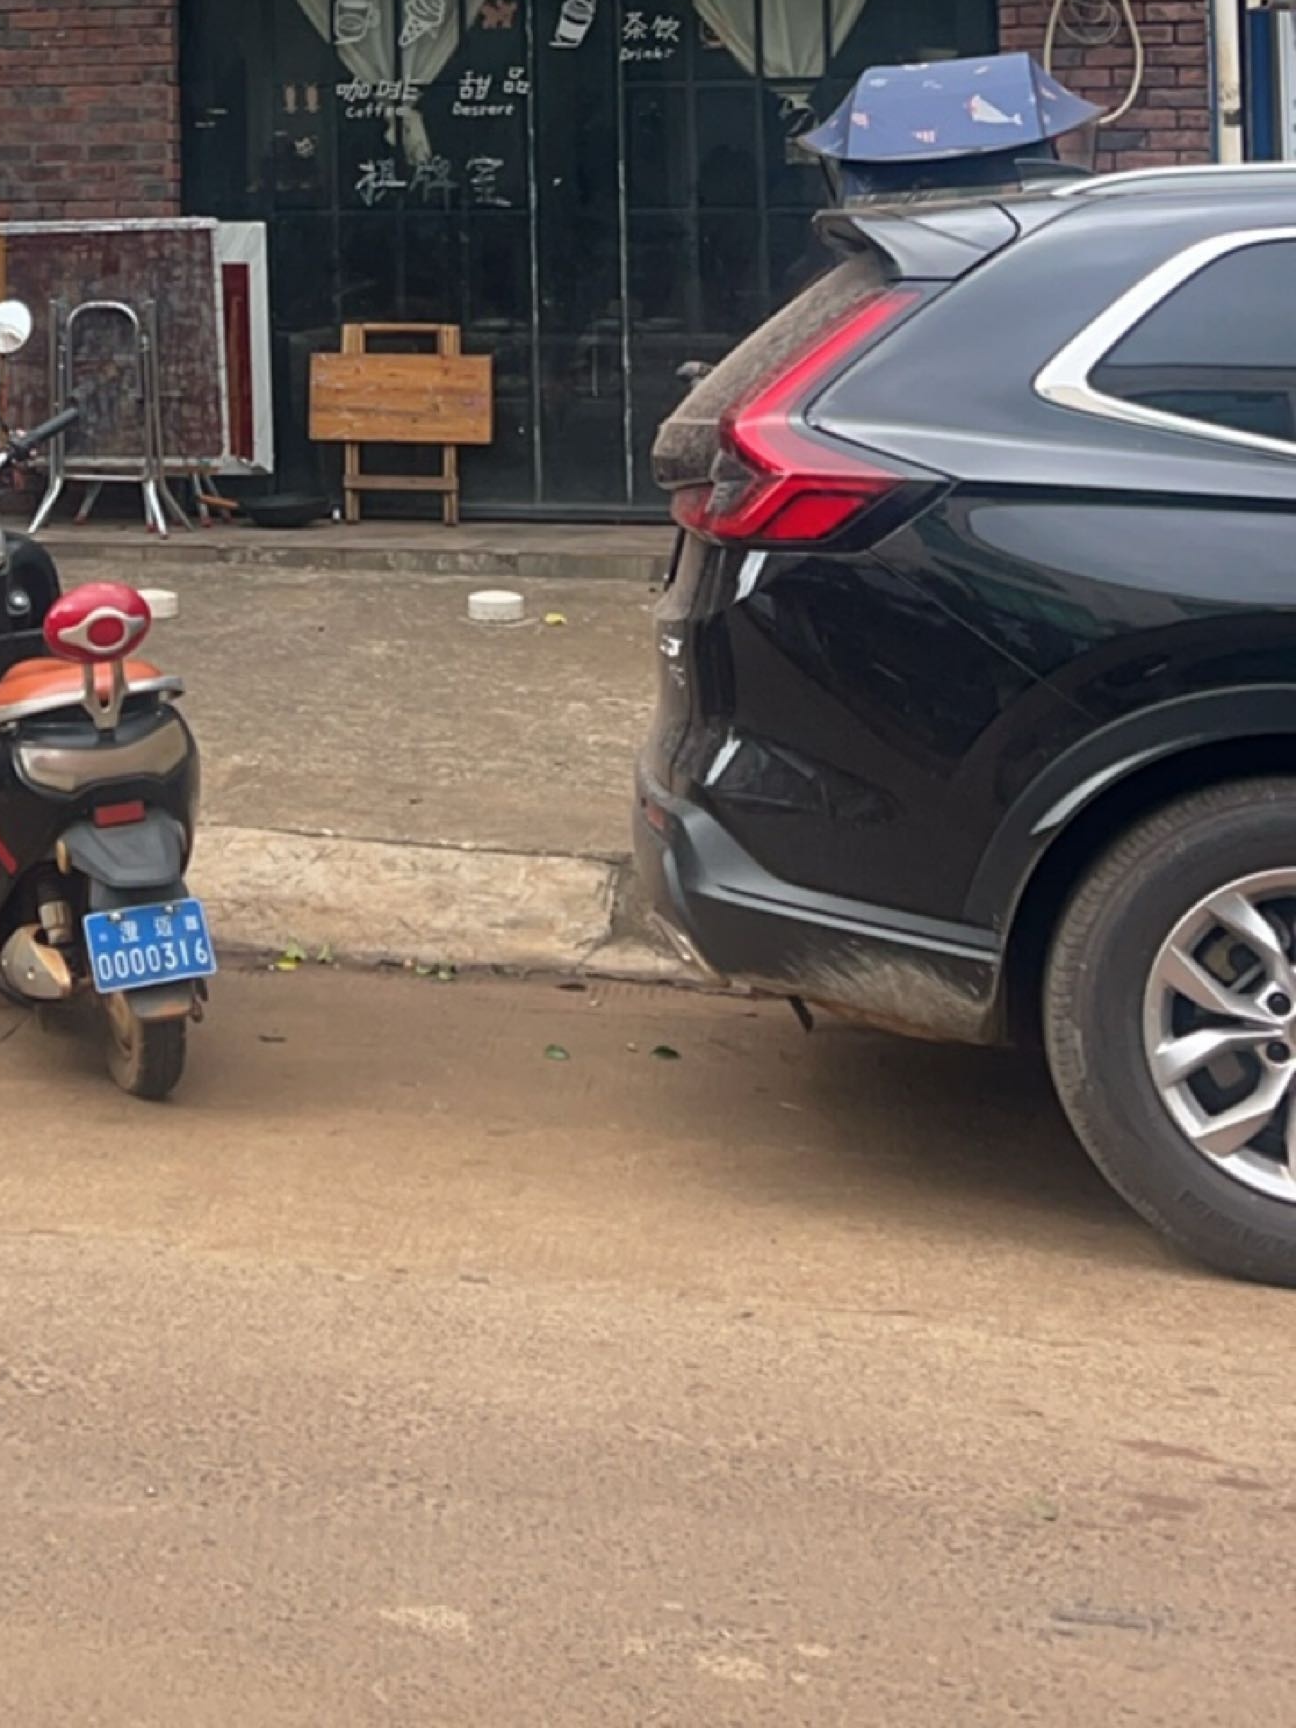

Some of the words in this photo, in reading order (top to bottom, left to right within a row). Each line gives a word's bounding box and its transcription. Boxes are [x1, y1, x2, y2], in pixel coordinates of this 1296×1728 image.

[622, 11, 680, 43] 茶饮
[458, 65, 531, 100] 甜品
[97, 936, 209, 981] 0000316
